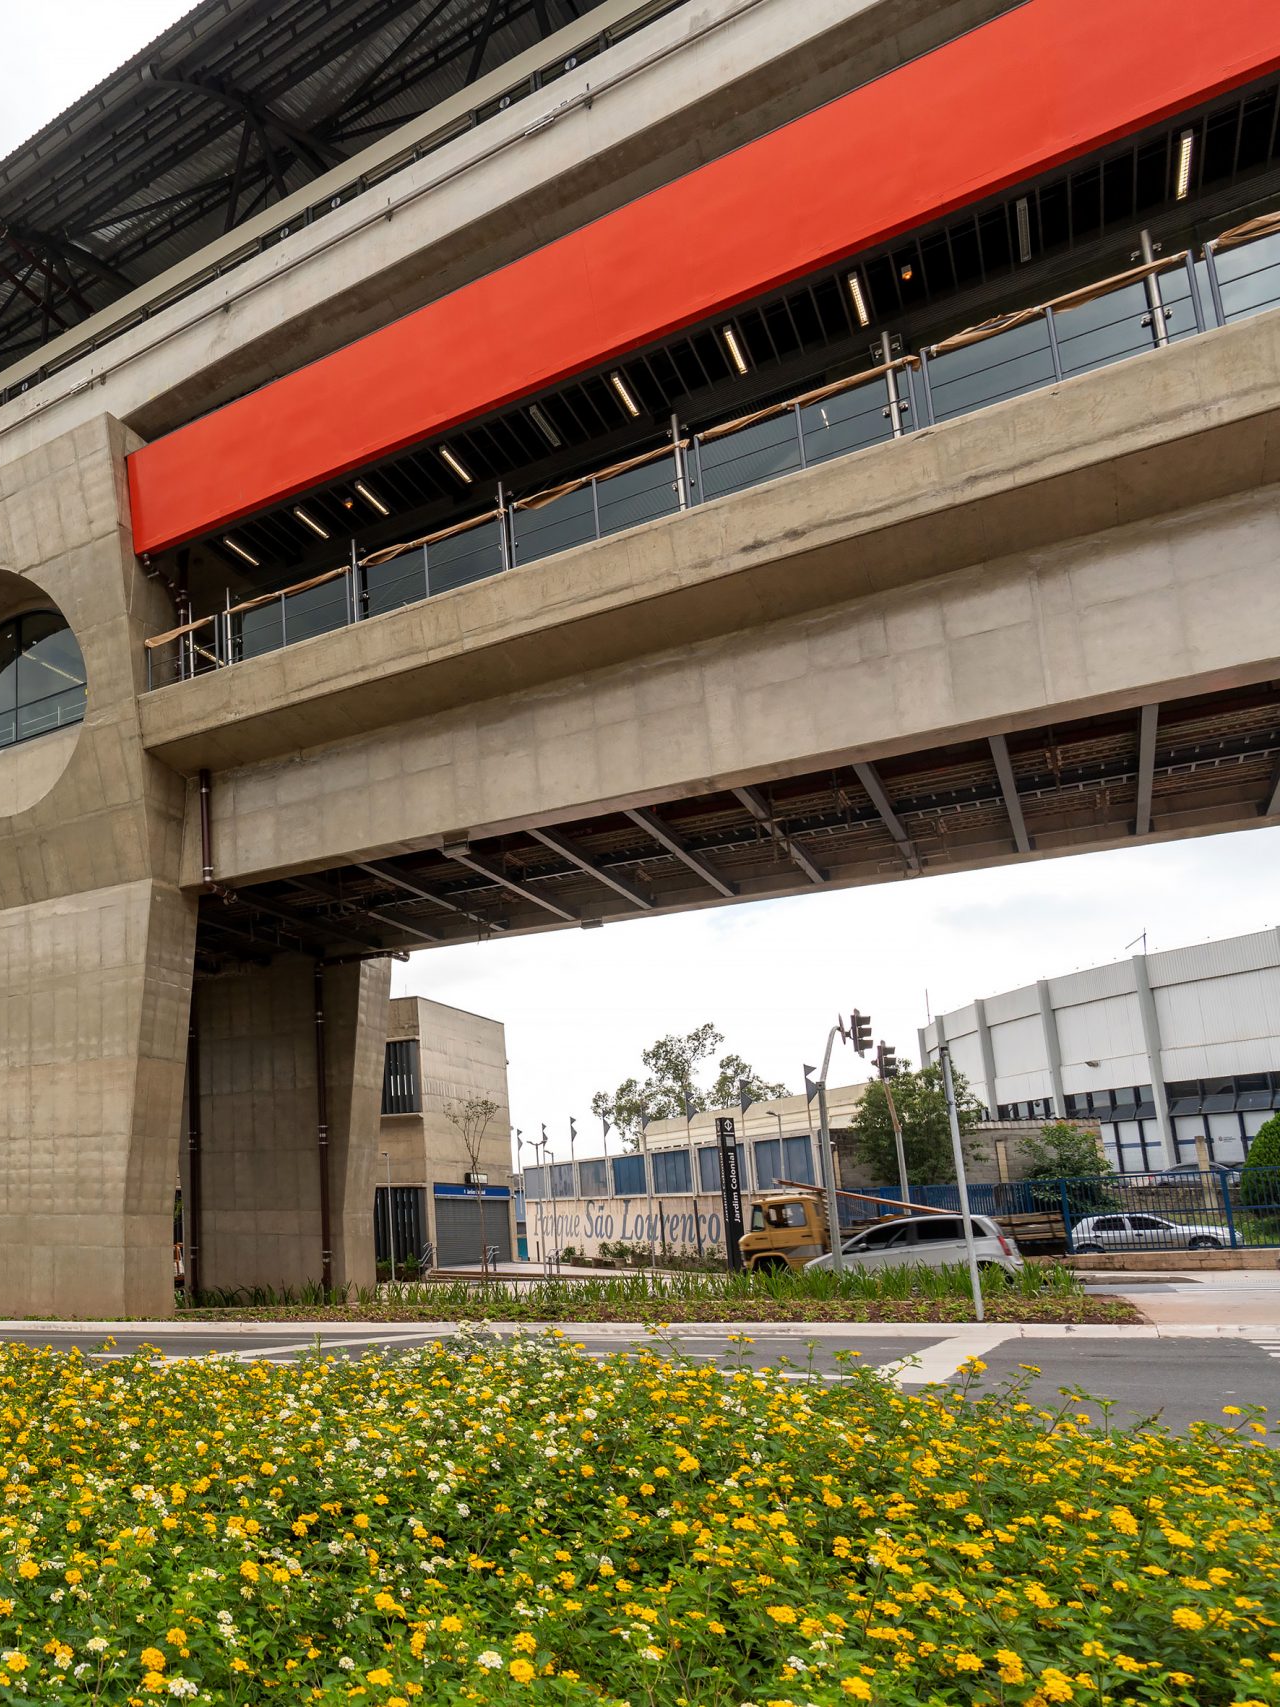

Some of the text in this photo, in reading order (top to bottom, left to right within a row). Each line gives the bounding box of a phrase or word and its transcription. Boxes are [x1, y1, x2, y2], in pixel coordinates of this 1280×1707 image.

[728, 1152, 741, 1223] Jardim Colonial
[534, 1199, 721, 1250] Parque São Lourenço
